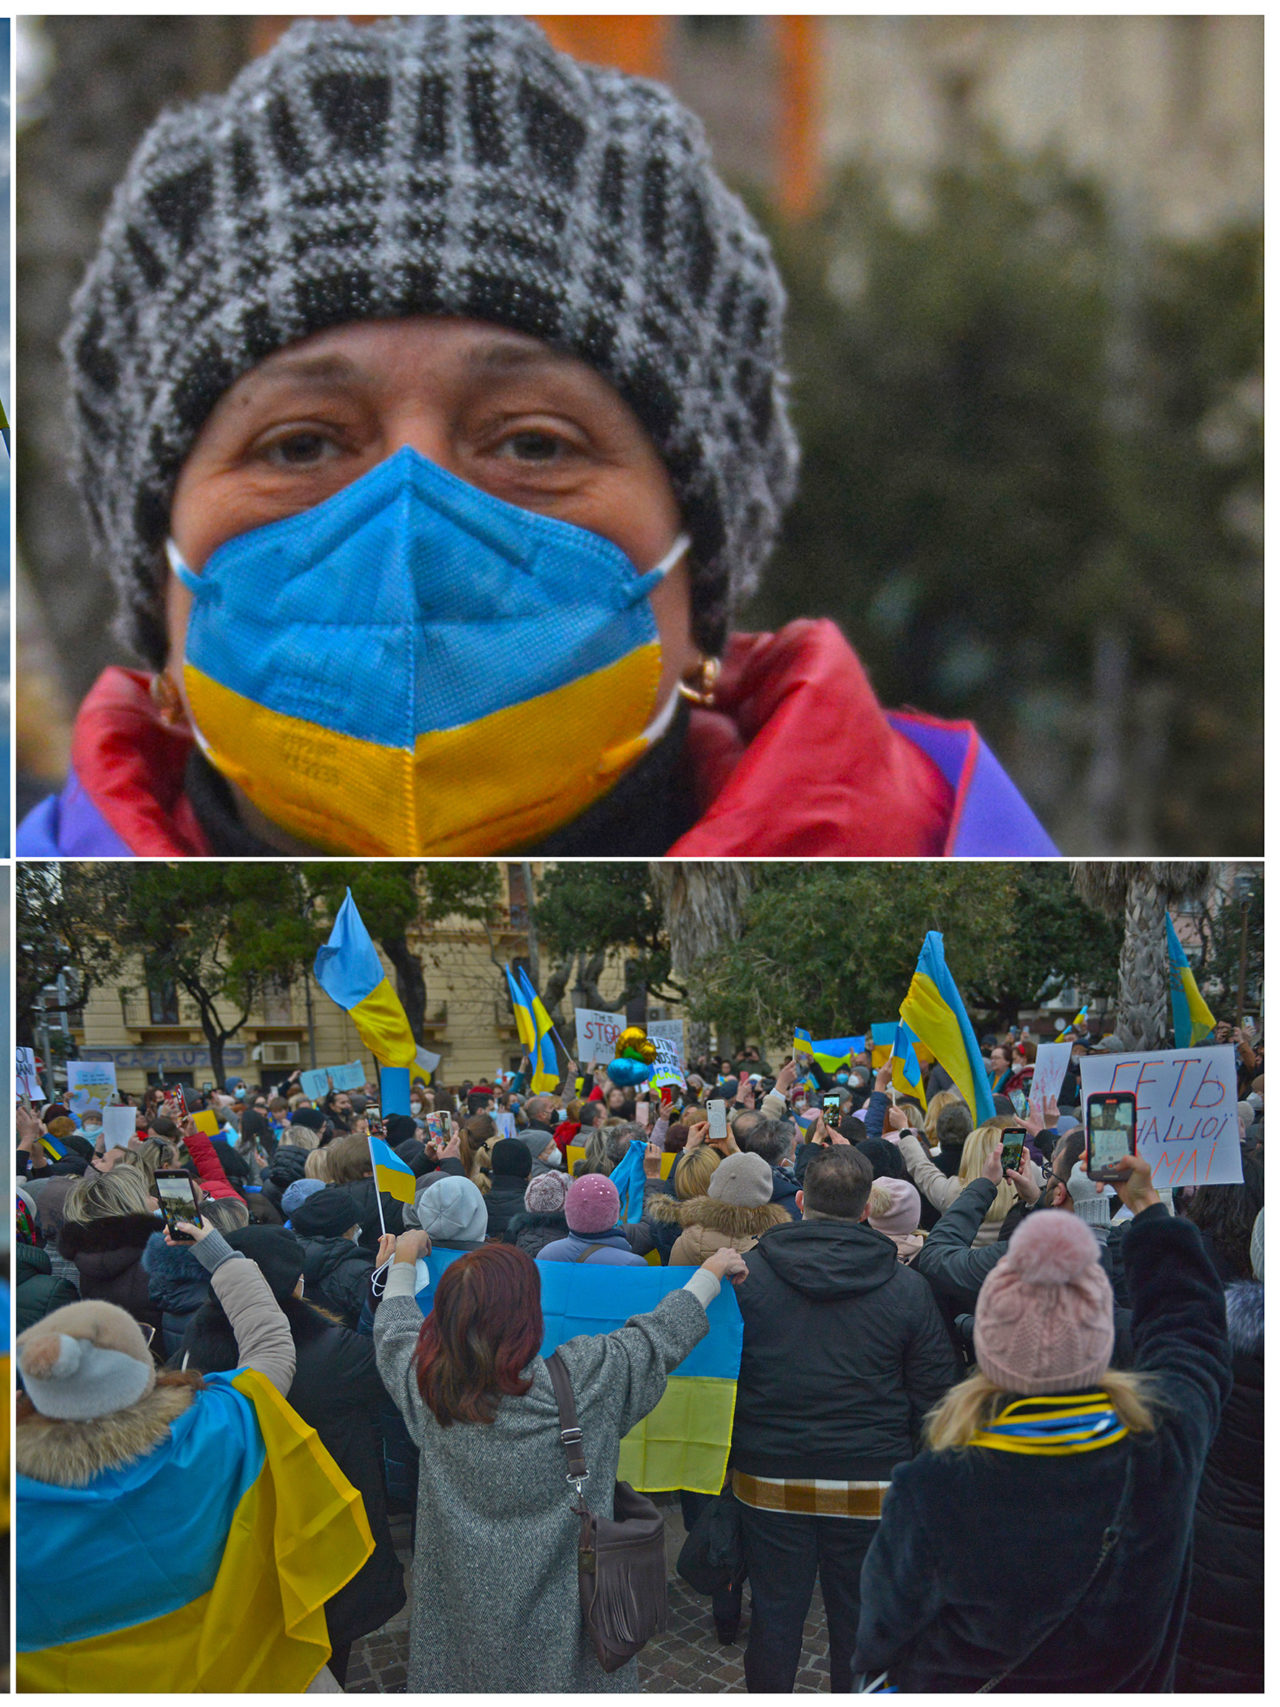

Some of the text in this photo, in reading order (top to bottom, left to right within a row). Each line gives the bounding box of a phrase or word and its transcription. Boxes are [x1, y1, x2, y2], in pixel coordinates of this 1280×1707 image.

[584, 1022, 621, 1044] STOP
[1109, 1058, 1226, 1109] ГЕТЬ
[1150, 1142, 1217, 1184] МЛІ
